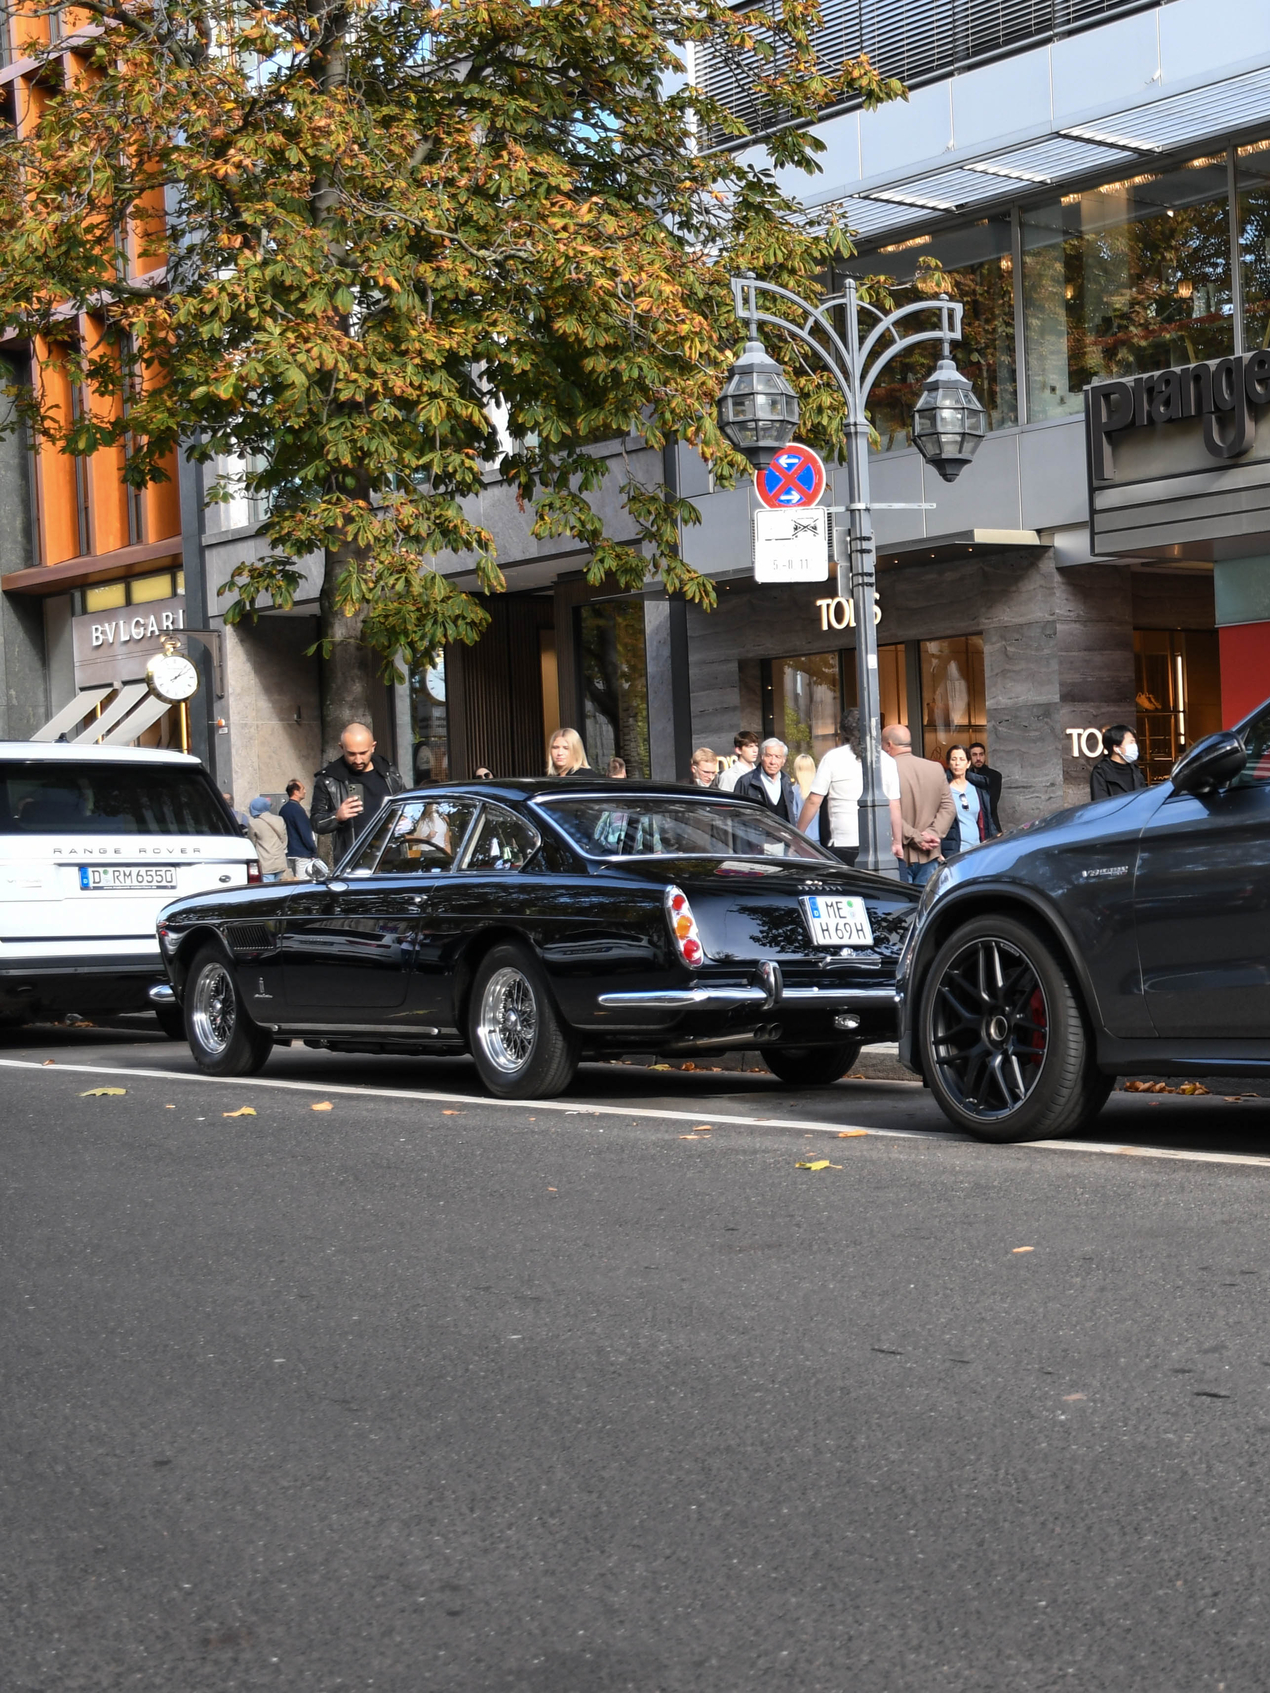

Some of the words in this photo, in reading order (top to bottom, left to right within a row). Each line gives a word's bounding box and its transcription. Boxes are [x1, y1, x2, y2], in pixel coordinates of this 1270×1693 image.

[91, 609, 185, 647] BVLGARI
[92, 870, 101, 884] D
[113, 870, 133, 884] RM
[136, 870, 173, 884] 6550
[825, 901, 847, 918] ME
